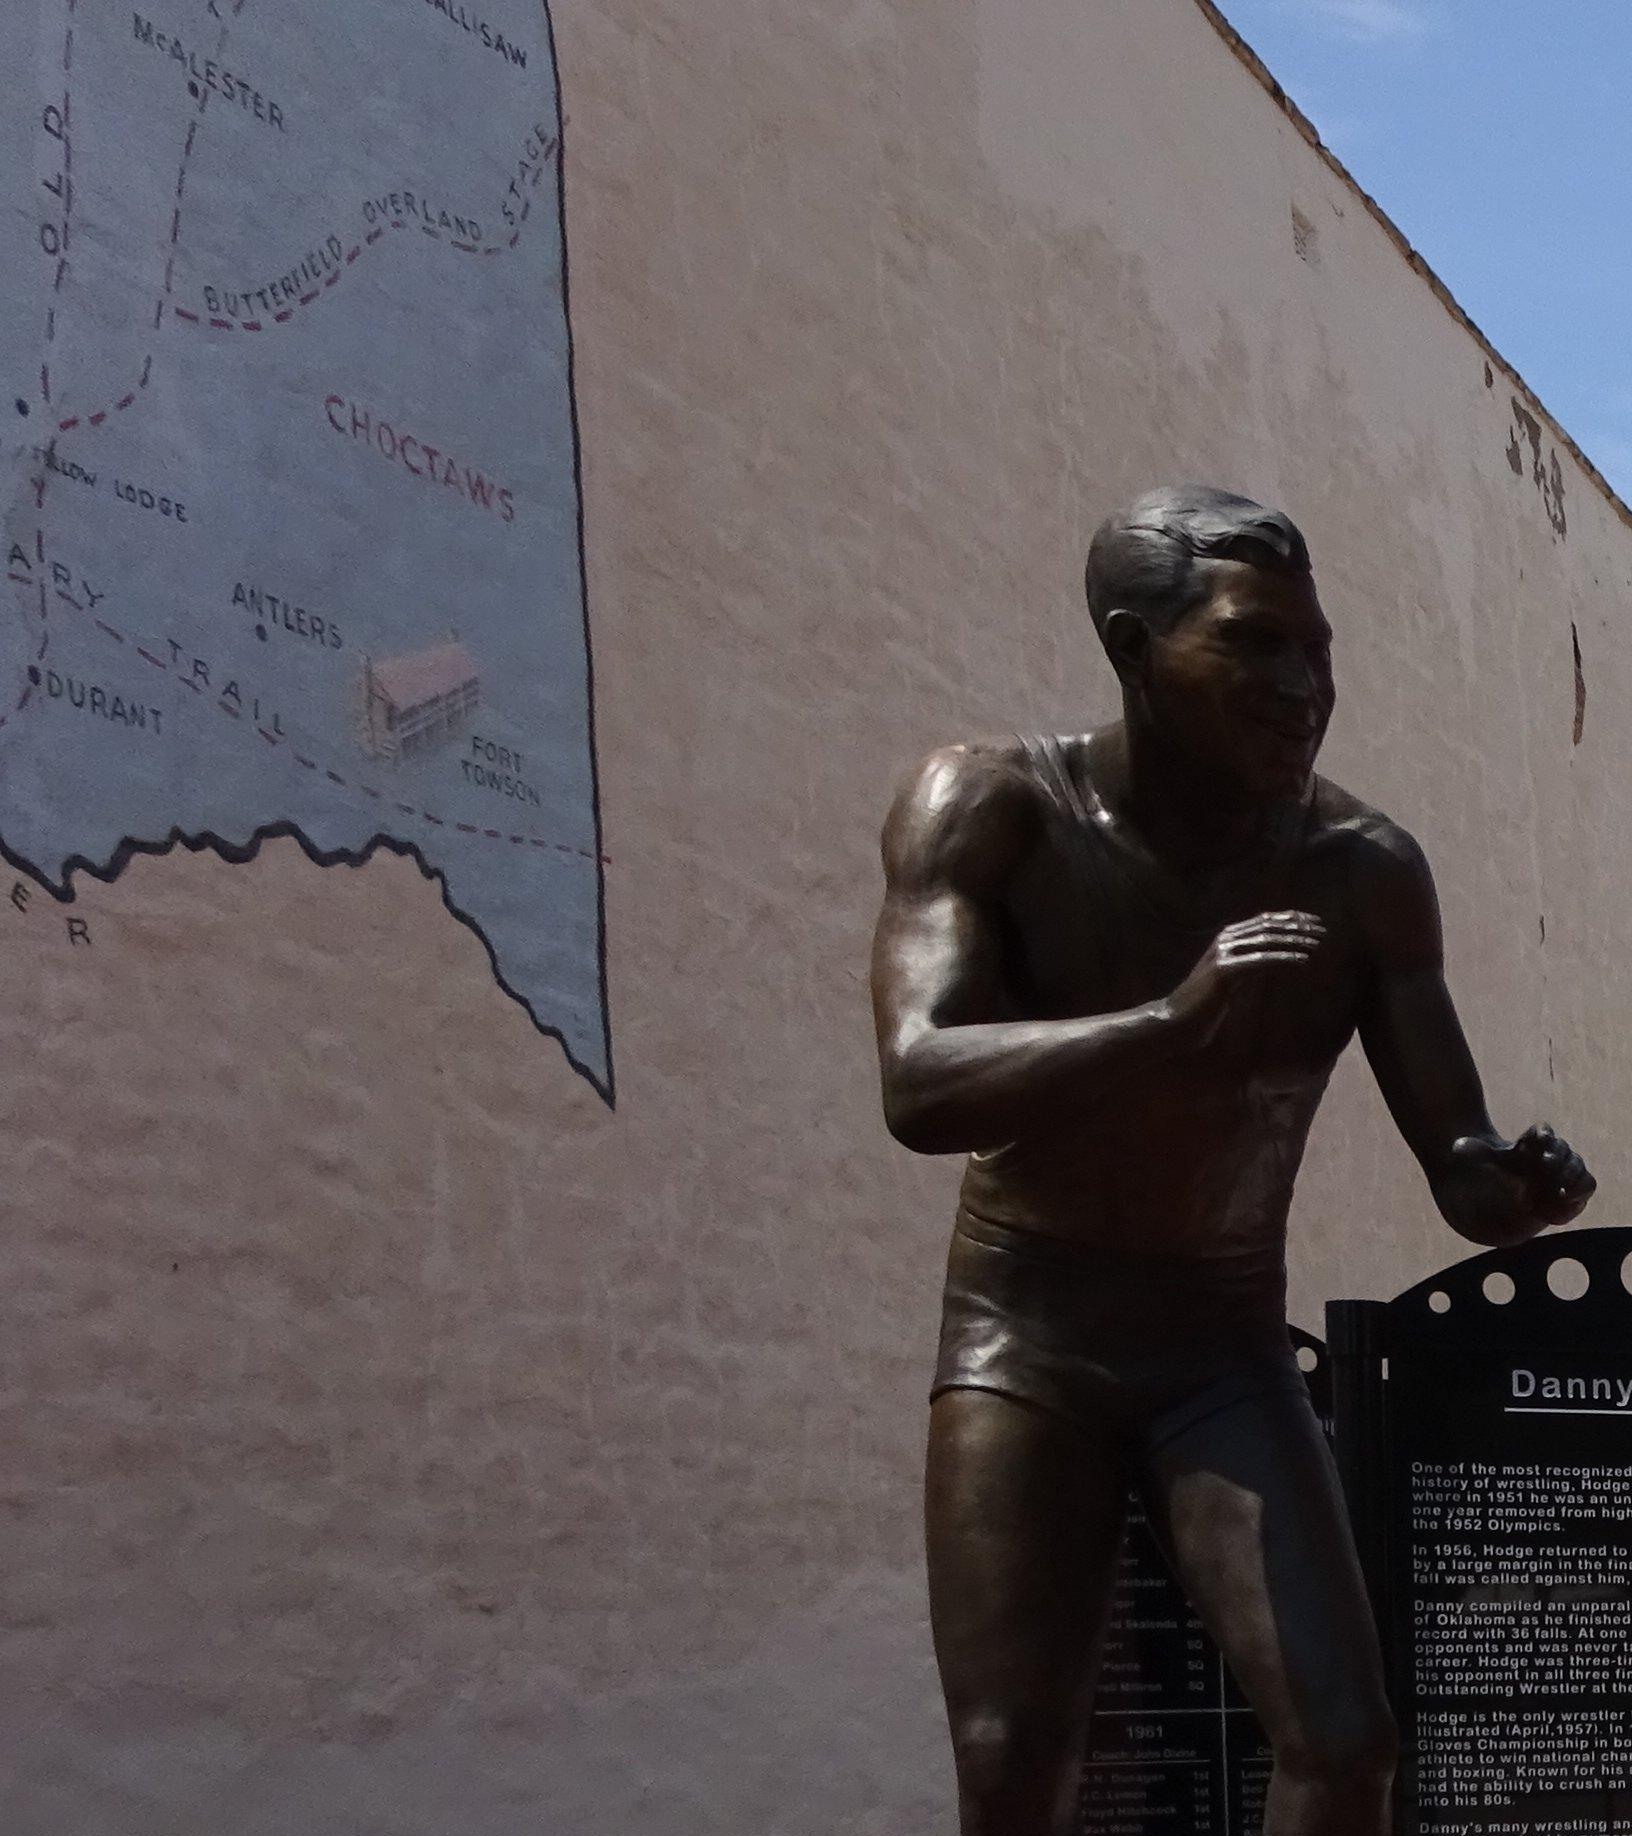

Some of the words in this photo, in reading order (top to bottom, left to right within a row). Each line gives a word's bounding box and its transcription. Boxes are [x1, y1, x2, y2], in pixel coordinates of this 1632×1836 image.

[425, 0, 527, 69] ALLISAW
[203, 234, 343, 317] BUTTERFIELD
[363, 191, 482, 242] OVERLAND
[501, 123, 549, 226] STAGE
[325, 394, 515, 523] CHOCTAWS
[114, 479, 189, 523] LODGE
[231, 581, 343, 650] ANTLERS
[46, 669, 162, 735] DURANT
[460, 760, 540, 806] TOWSON
[472, 736, 523, 774] FORT
[1411, 1461, 1443, 1474] One
[1448, 1462, 1465, 1474] of
[1471, 1462, 1497, 1475] the
[1502, 1464, 1541, 1476] most
[1546, 1465, 1632, 1479] recognized
[1413, 1518, 1438, 1530] the
[1444, 1518, 1482, 1531] 1952
[1487, 1519, 1565, 1533] Olympics.
